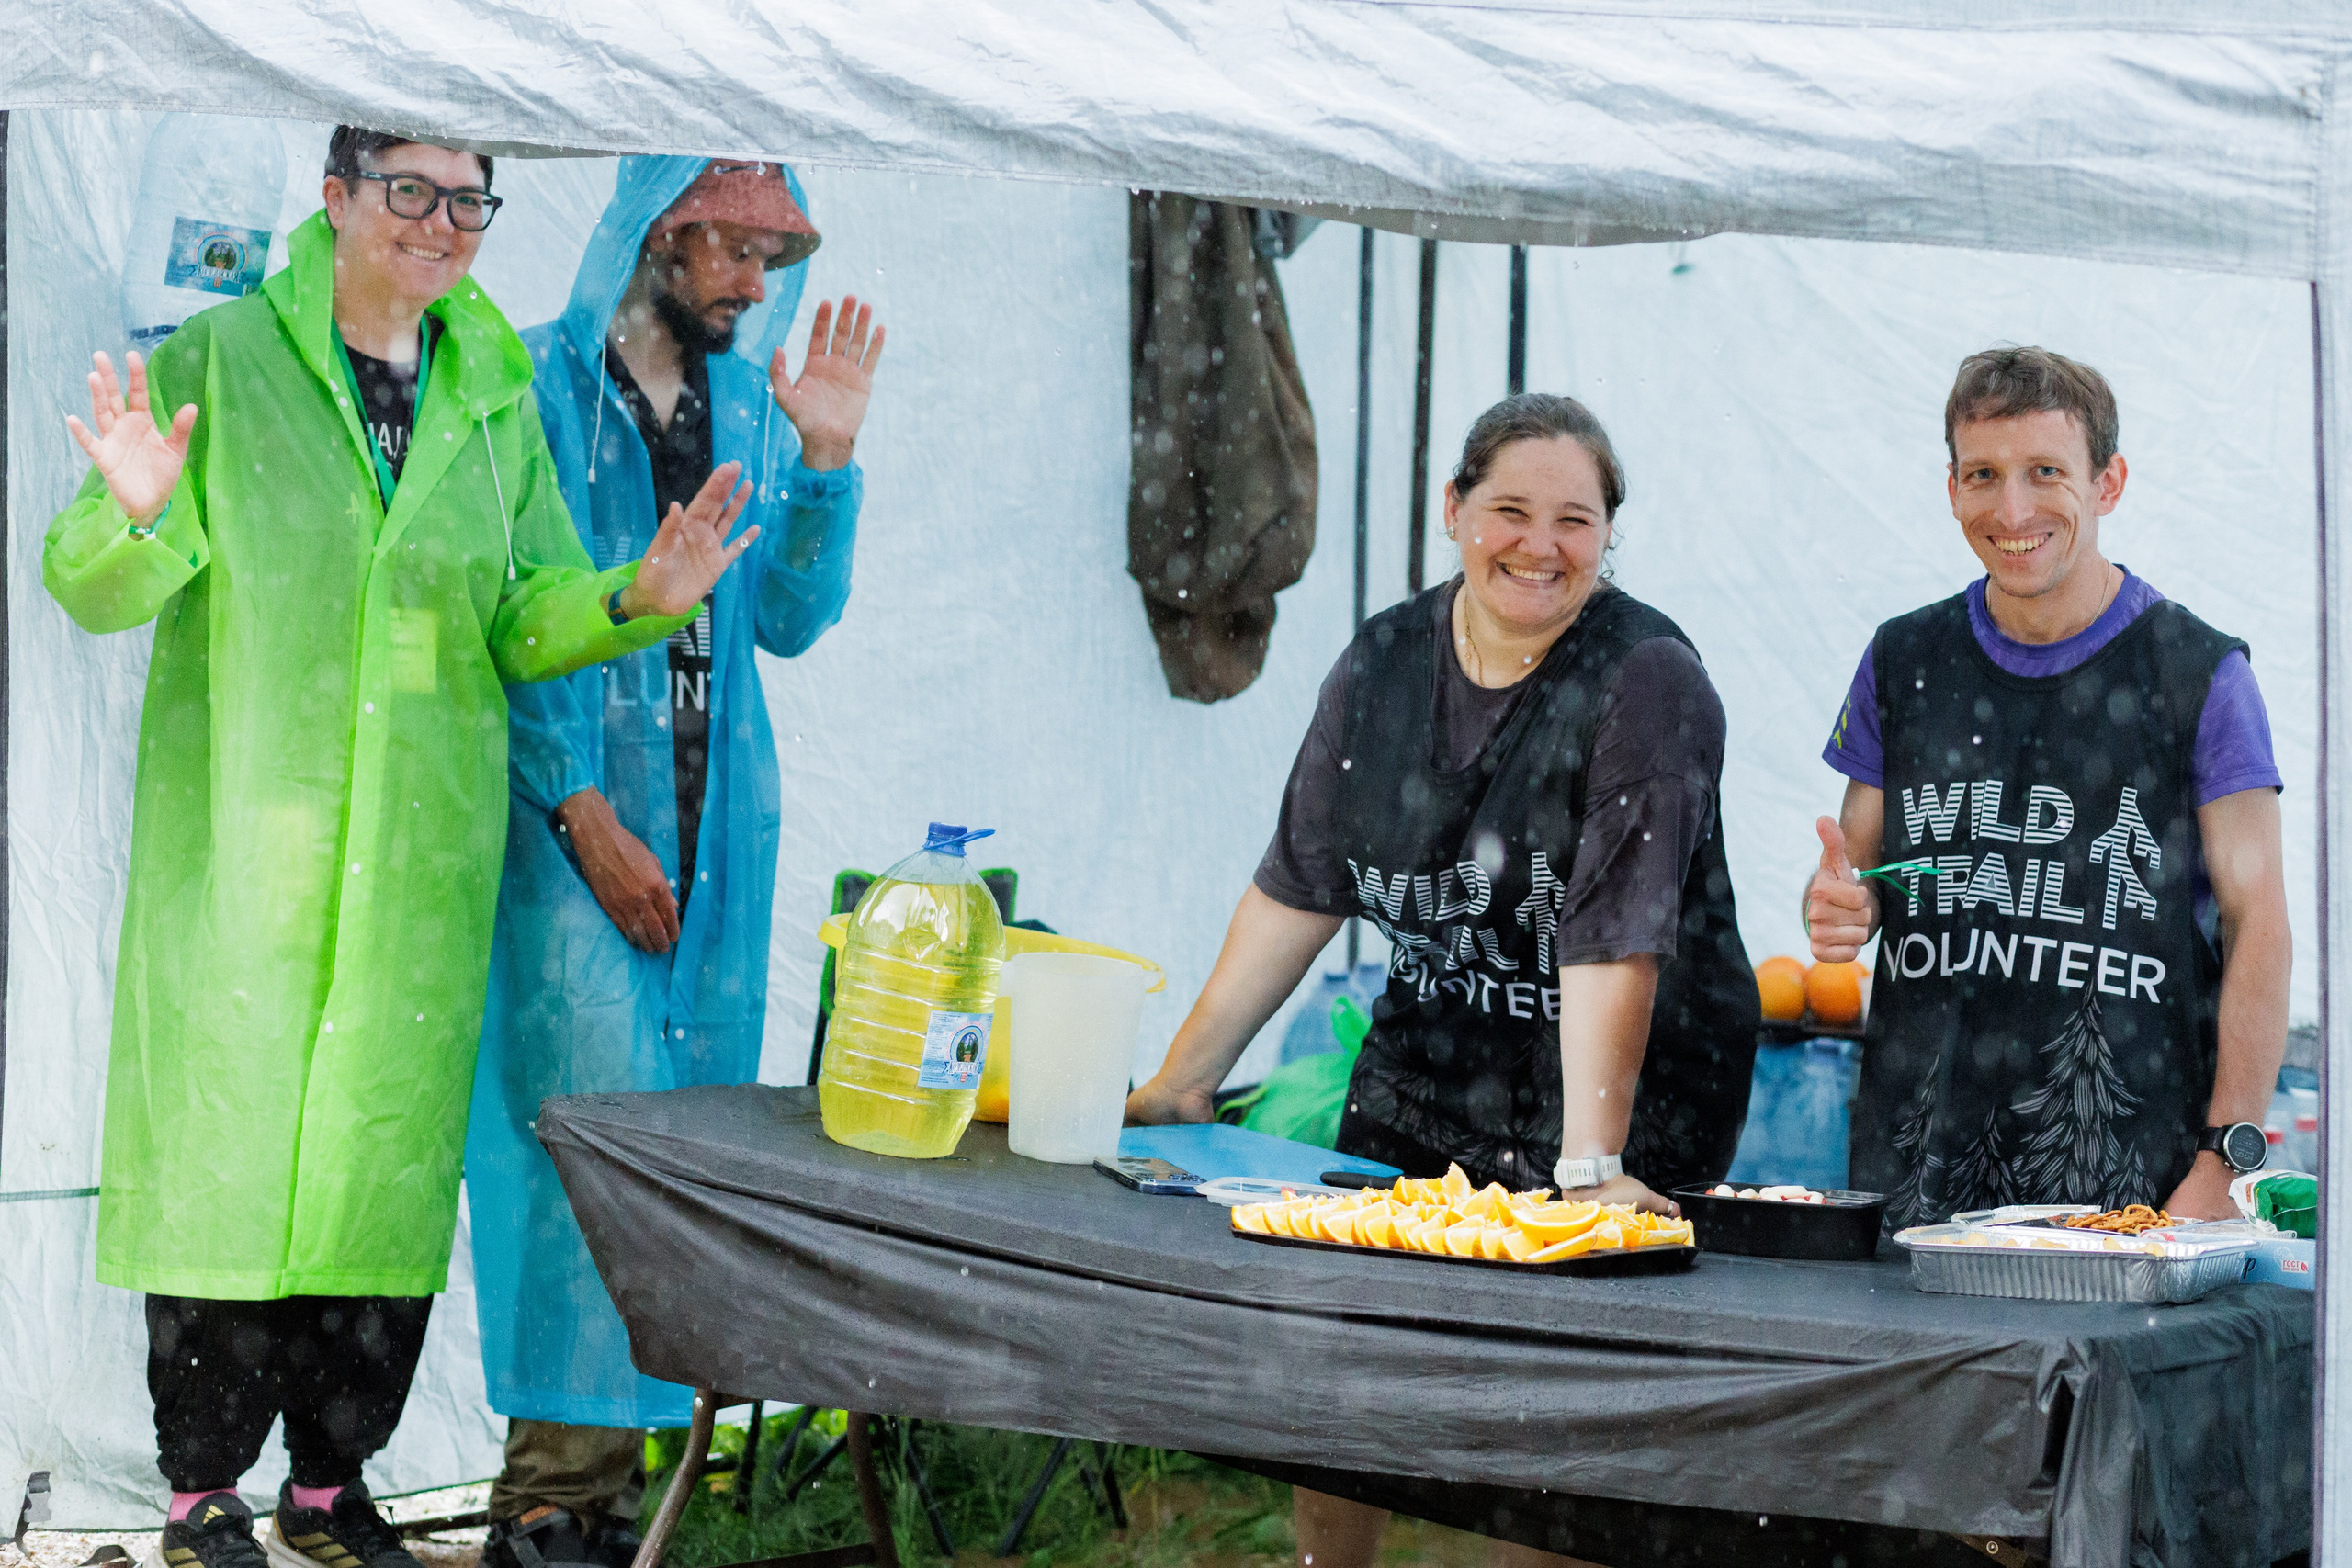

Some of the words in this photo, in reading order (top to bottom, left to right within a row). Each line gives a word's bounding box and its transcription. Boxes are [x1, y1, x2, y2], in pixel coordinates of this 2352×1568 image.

[1901, 779, 2075, 846] WILD
[1347, 858, 1491, 921] WILD
[1901, 852, 2085, 925] TRAIL
[1883, 928, 2166, 1004] VOLUNTEER
